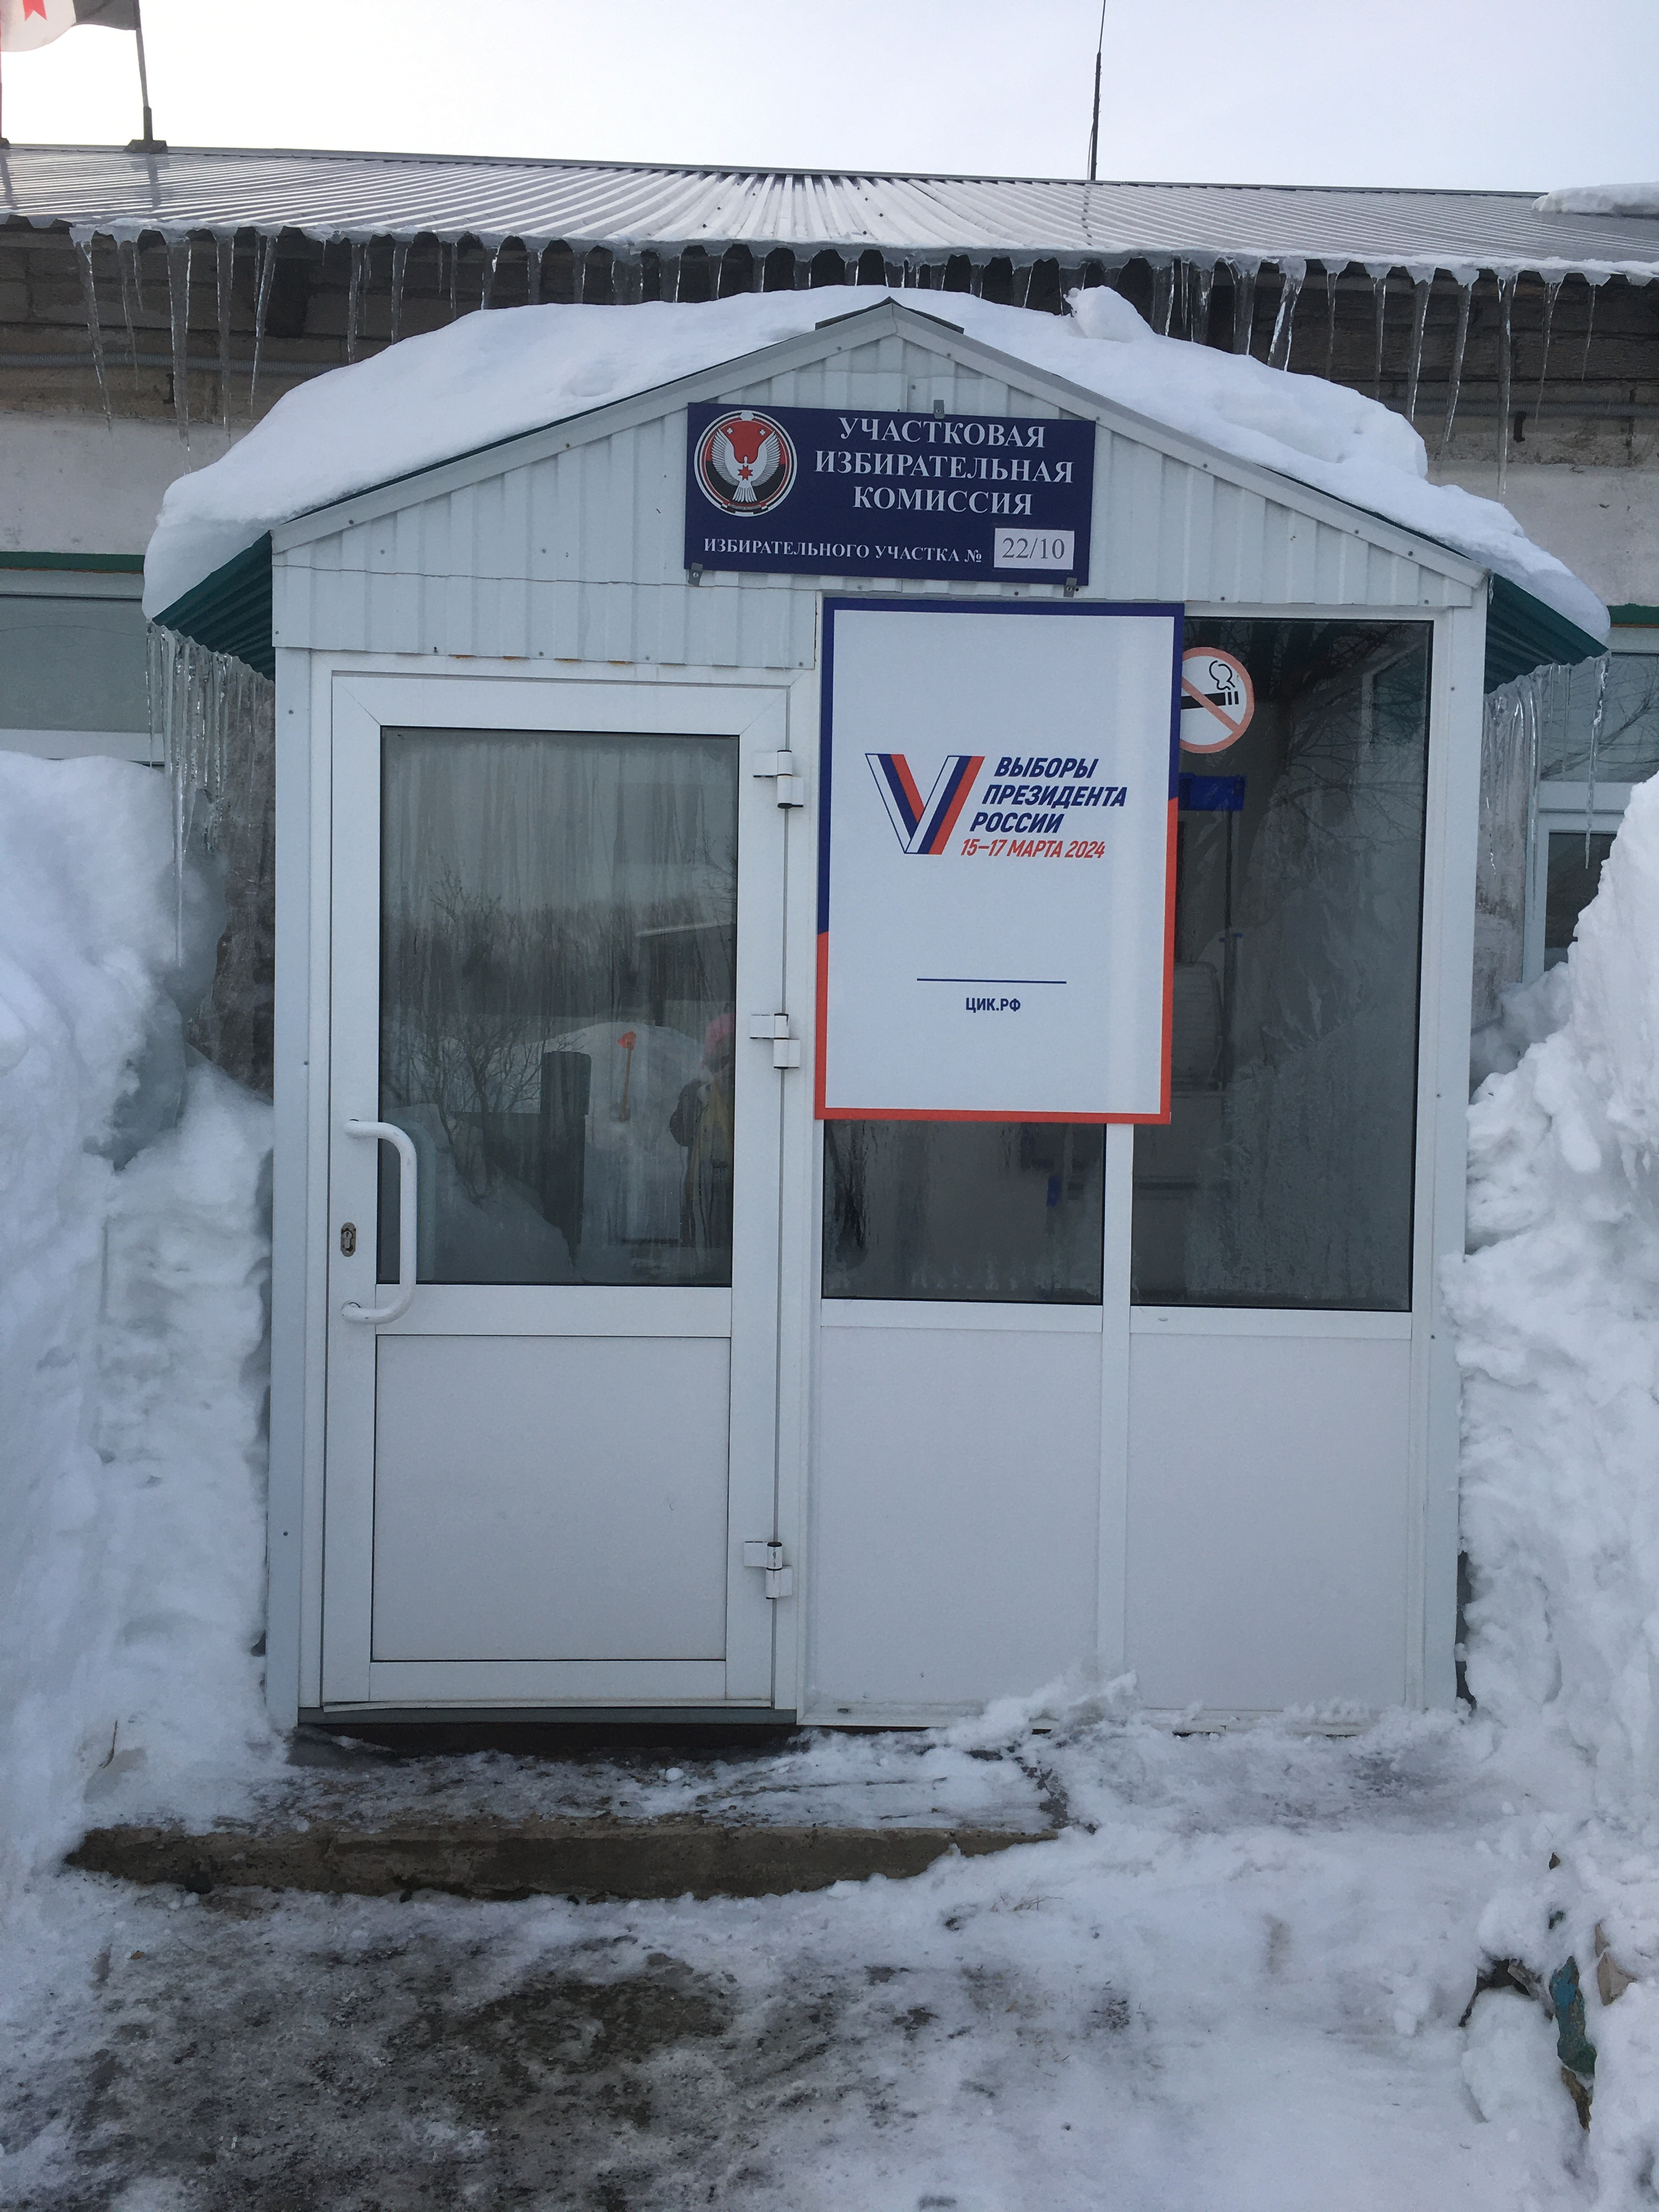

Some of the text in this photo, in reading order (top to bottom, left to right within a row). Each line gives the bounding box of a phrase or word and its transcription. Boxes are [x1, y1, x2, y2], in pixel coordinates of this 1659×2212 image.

[839, 417, 1046, 448] УЧАСТКОВАЯ
[815, 450, 1074, 483] ИЗБИРАТЕЛЬНАЯ
[854, 486, 1032, 515] КОМИССИЯ
[704, 538, 1064, 562] ИЗБИРАТЕЛЬНОГО УЧАСТКА № 22/10
[994, 757, 1099, 778] ВЫБОРЫ
[982, 785, 1127, 809] ПРЕЗИДЕНТА
[969, 812, 1065, 833] РОССИИ
[1006, 839, 1063, 858] МАРТА
[1064, 840, 1105, 859] 2024
[966, 997, 1020, 1013] ЦИК.РФ
